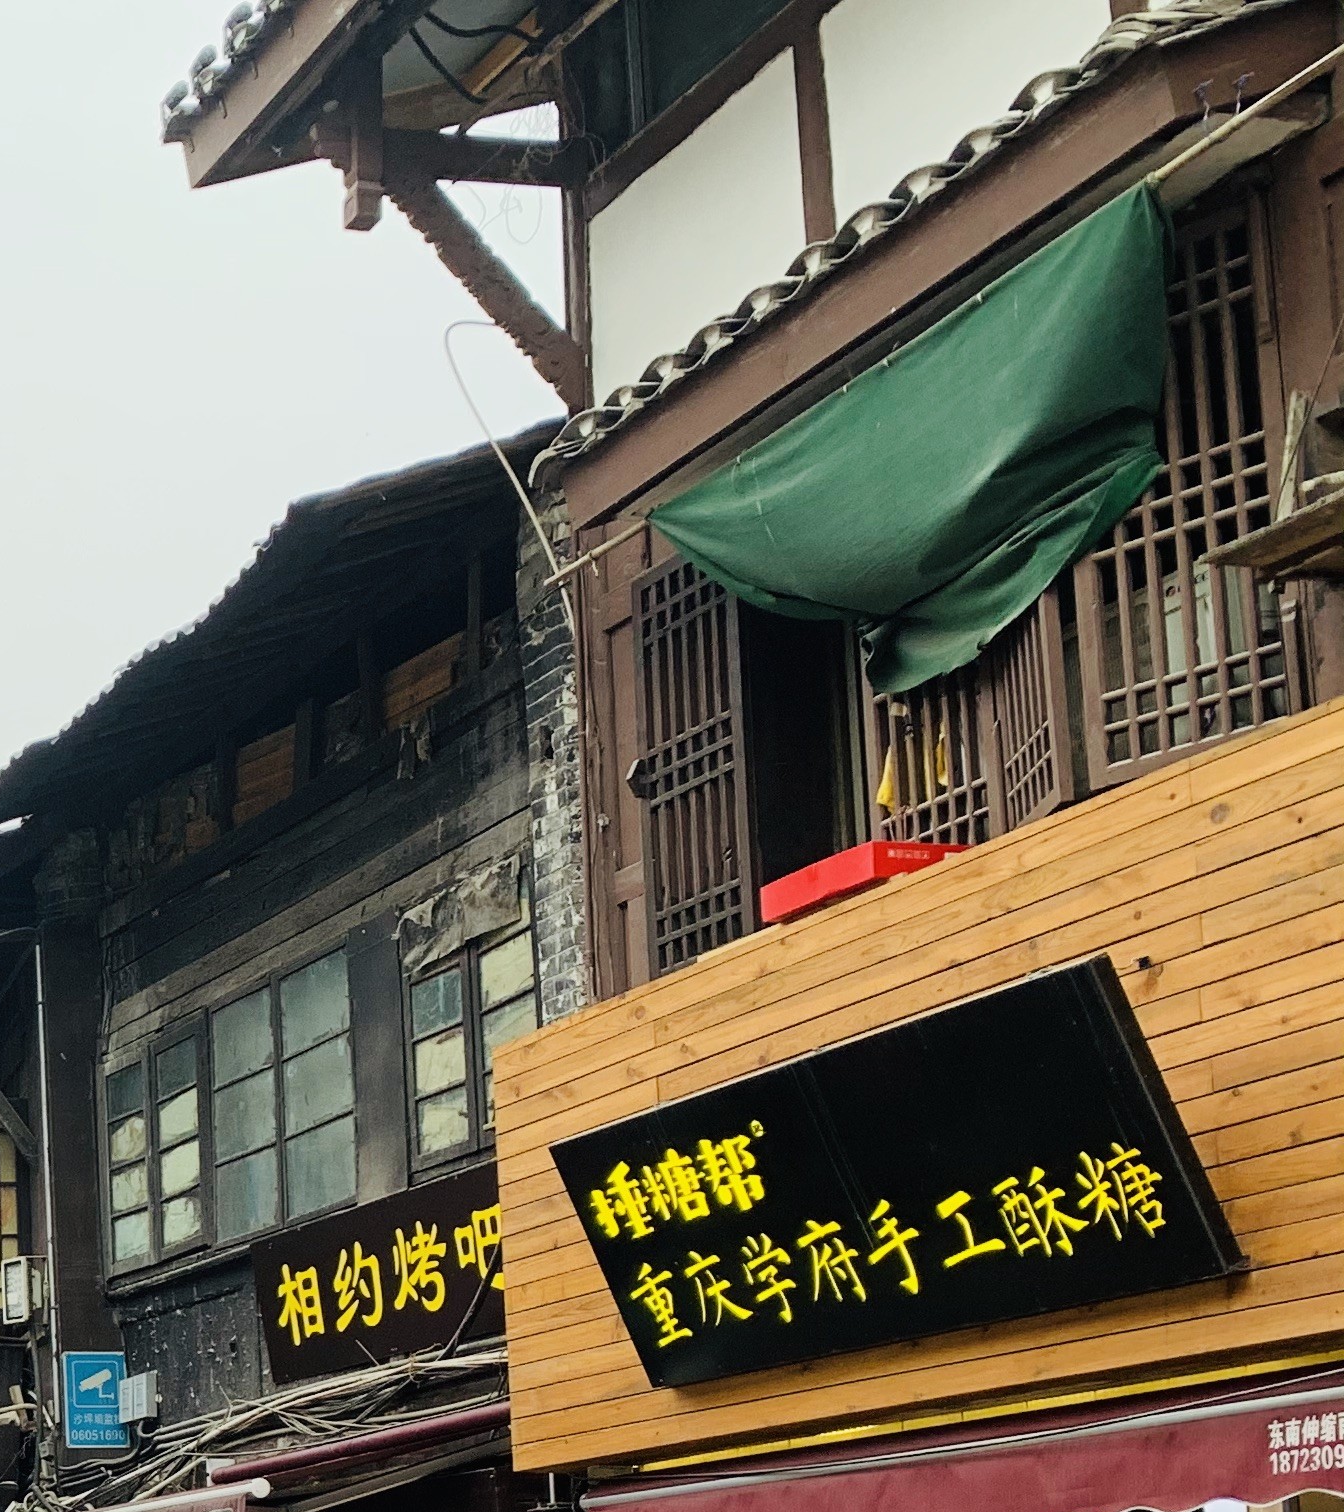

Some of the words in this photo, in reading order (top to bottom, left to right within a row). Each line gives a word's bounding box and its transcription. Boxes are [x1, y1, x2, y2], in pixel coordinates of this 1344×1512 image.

[276, 1202, 504, 1346] 相约烤吧
[628, 1143, 1168, 1349] 重庆学府手工酥糖
[72, 1429, 125, 1440] 06051690
